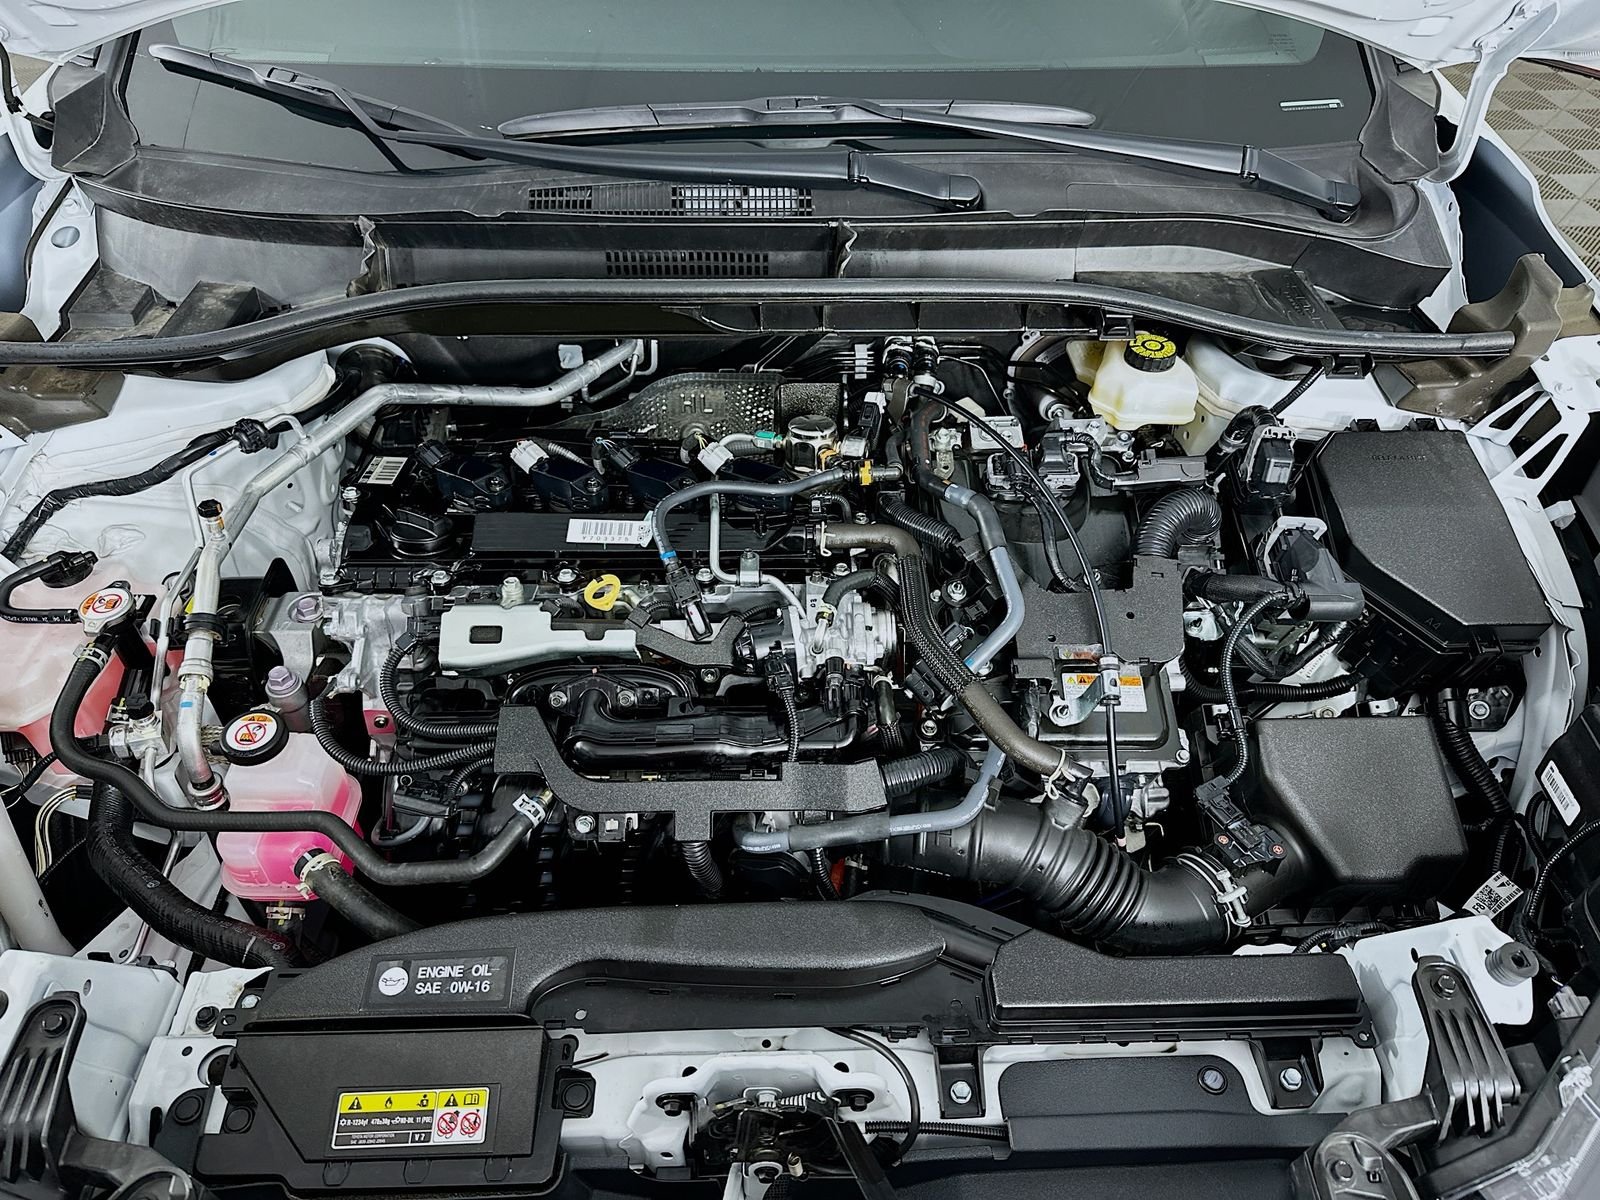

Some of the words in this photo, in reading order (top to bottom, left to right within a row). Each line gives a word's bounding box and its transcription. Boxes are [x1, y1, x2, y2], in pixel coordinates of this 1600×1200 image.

[1472, 903, 1486, 913] F8
[417, 965, 465, 979] ENGINE
[471, 964, 492, 977] OIL
[415, 982, 442, 994] SAE
[450, 980, 491, 993] 0W-16
